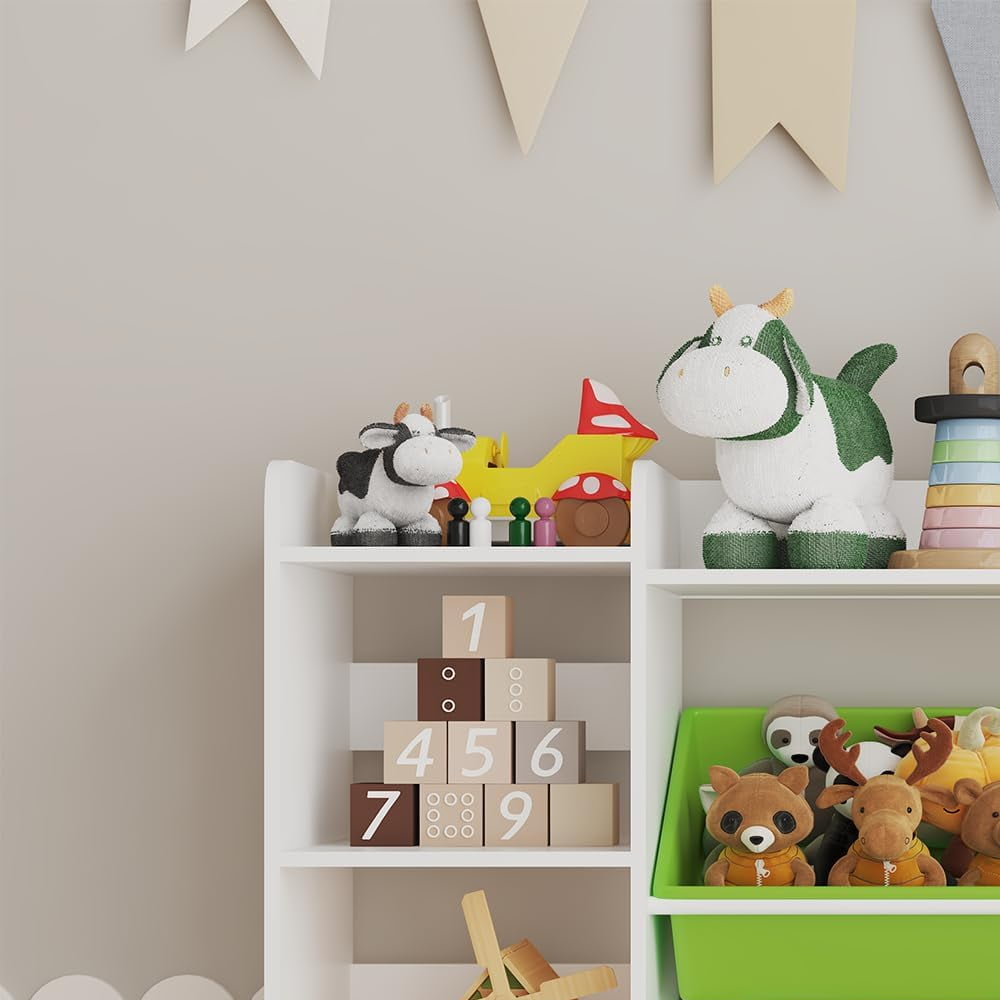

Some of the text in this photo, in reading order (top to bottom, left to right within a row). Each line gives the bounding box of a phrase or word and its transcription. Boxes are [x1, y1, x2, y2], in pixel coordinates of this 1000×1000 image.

[462, 602, 486, 652] 1
[396, 728, 434, 777] 4
[461, 728, 498, 777] 5
[530, 727, 564, 777] 6
[362, 790, 401, 840] 7
[499, 790, 533, 841] 9
